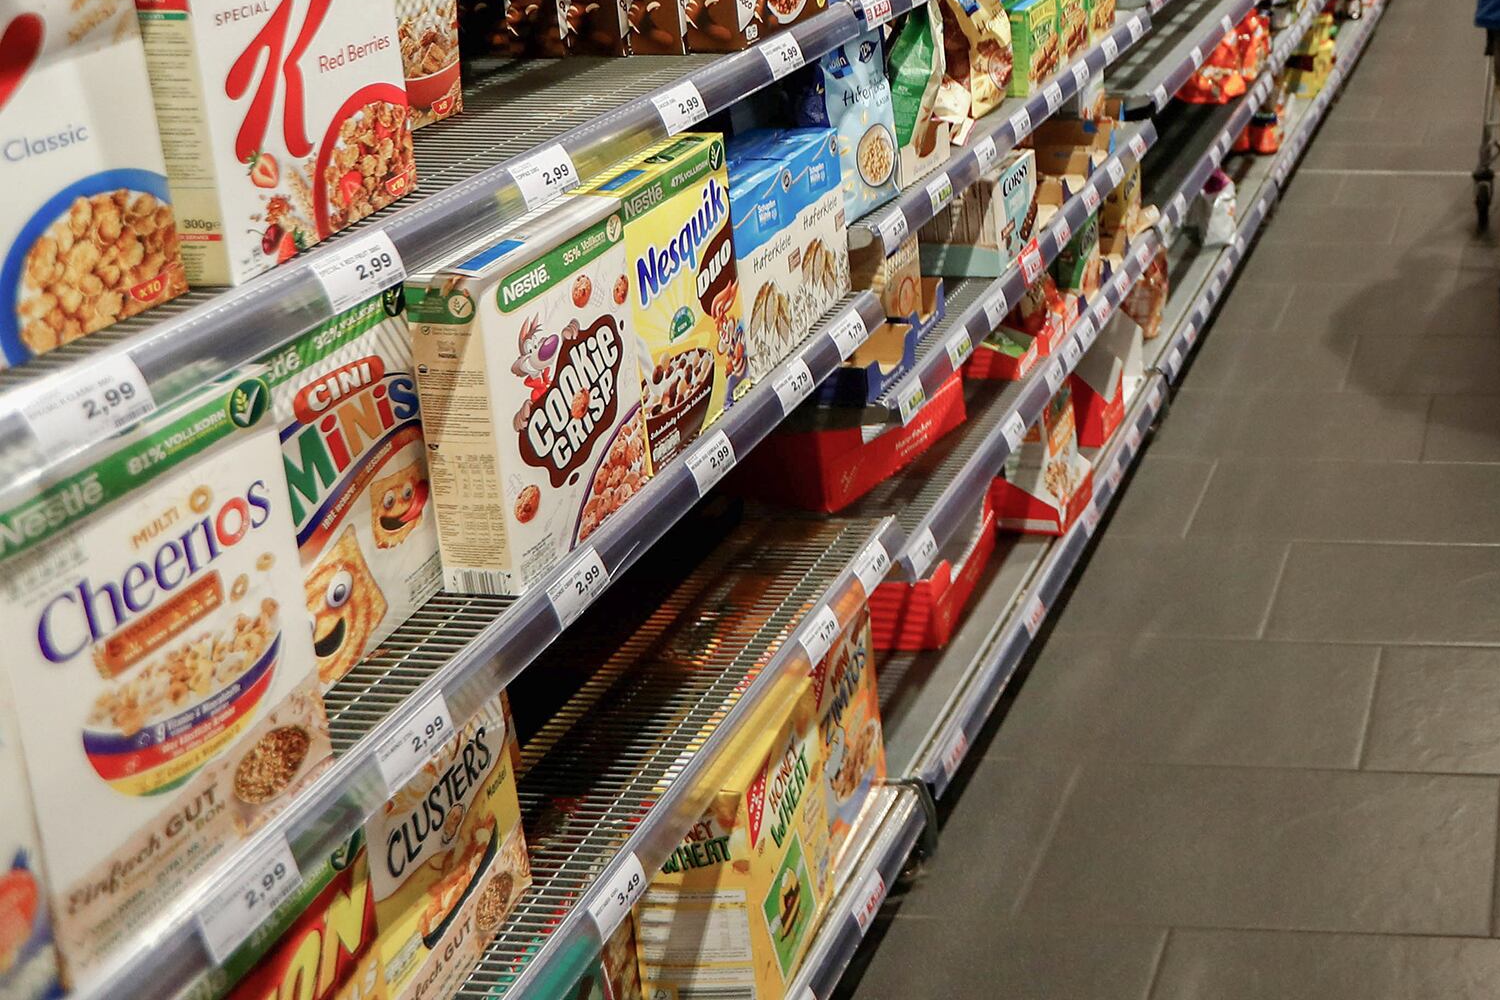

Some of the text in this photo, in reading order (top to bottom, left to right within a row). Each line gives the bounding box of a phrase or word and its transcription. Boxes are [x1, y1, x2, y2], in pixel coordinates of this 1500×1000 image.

[215, 1, 270, 26] SPECIAL
[874, 0, 891, 17] 2,99
[319, 34, 390, 73] Red Berries
[780, 45, 799, 63] 2,99
[678, 95, 701, 114] 2,99
[2, 125, 90, 162] Classic
[542, 163, 570, 187] 2,99
[623, 173, 685, 220] Nestlé 47%
[803, 197, 838, 231] Haferkleie
[562, 247, 582, 268] 35%
[635, 178, 726, 306] Nesquik
[752, 233, 792, 274] Haferkleie
[356, 252, 392, 281] 2,99
[847, 323, 863, 341] 1,79
[83, 381, 137, 419] 2,99
[306, 359, 376, 414] CINI
[527, 324, 620, 459] COOKIE
[791, 371, 809, 392] 2,79
[165, 410, 227, 447] VOLLKORN
[709, 446, 730, 469] 2,99
[132, 506, 181, 549] MULTI
[37, 479, 270, 664] Cheerios
[575, 564, 601, 595] 2,99
[871, 554, 886, 574] 1,89
[818, 621, 837, 643] 1,79
[412, 715, 444, 752] 2,99
[769, 736, 797, 815] HONEY
[165, 783, 218, 838] GUT
[387, 727, 491, 878] CLUSTERS
[771, 743, 809, 849] WHEAT
[661, 835, 733, 875] WHEAT
[244, 860, 287, 908] 2,99
[616, 873, 641, 906] 3,49
[443, 917, 473, 962] GUT
